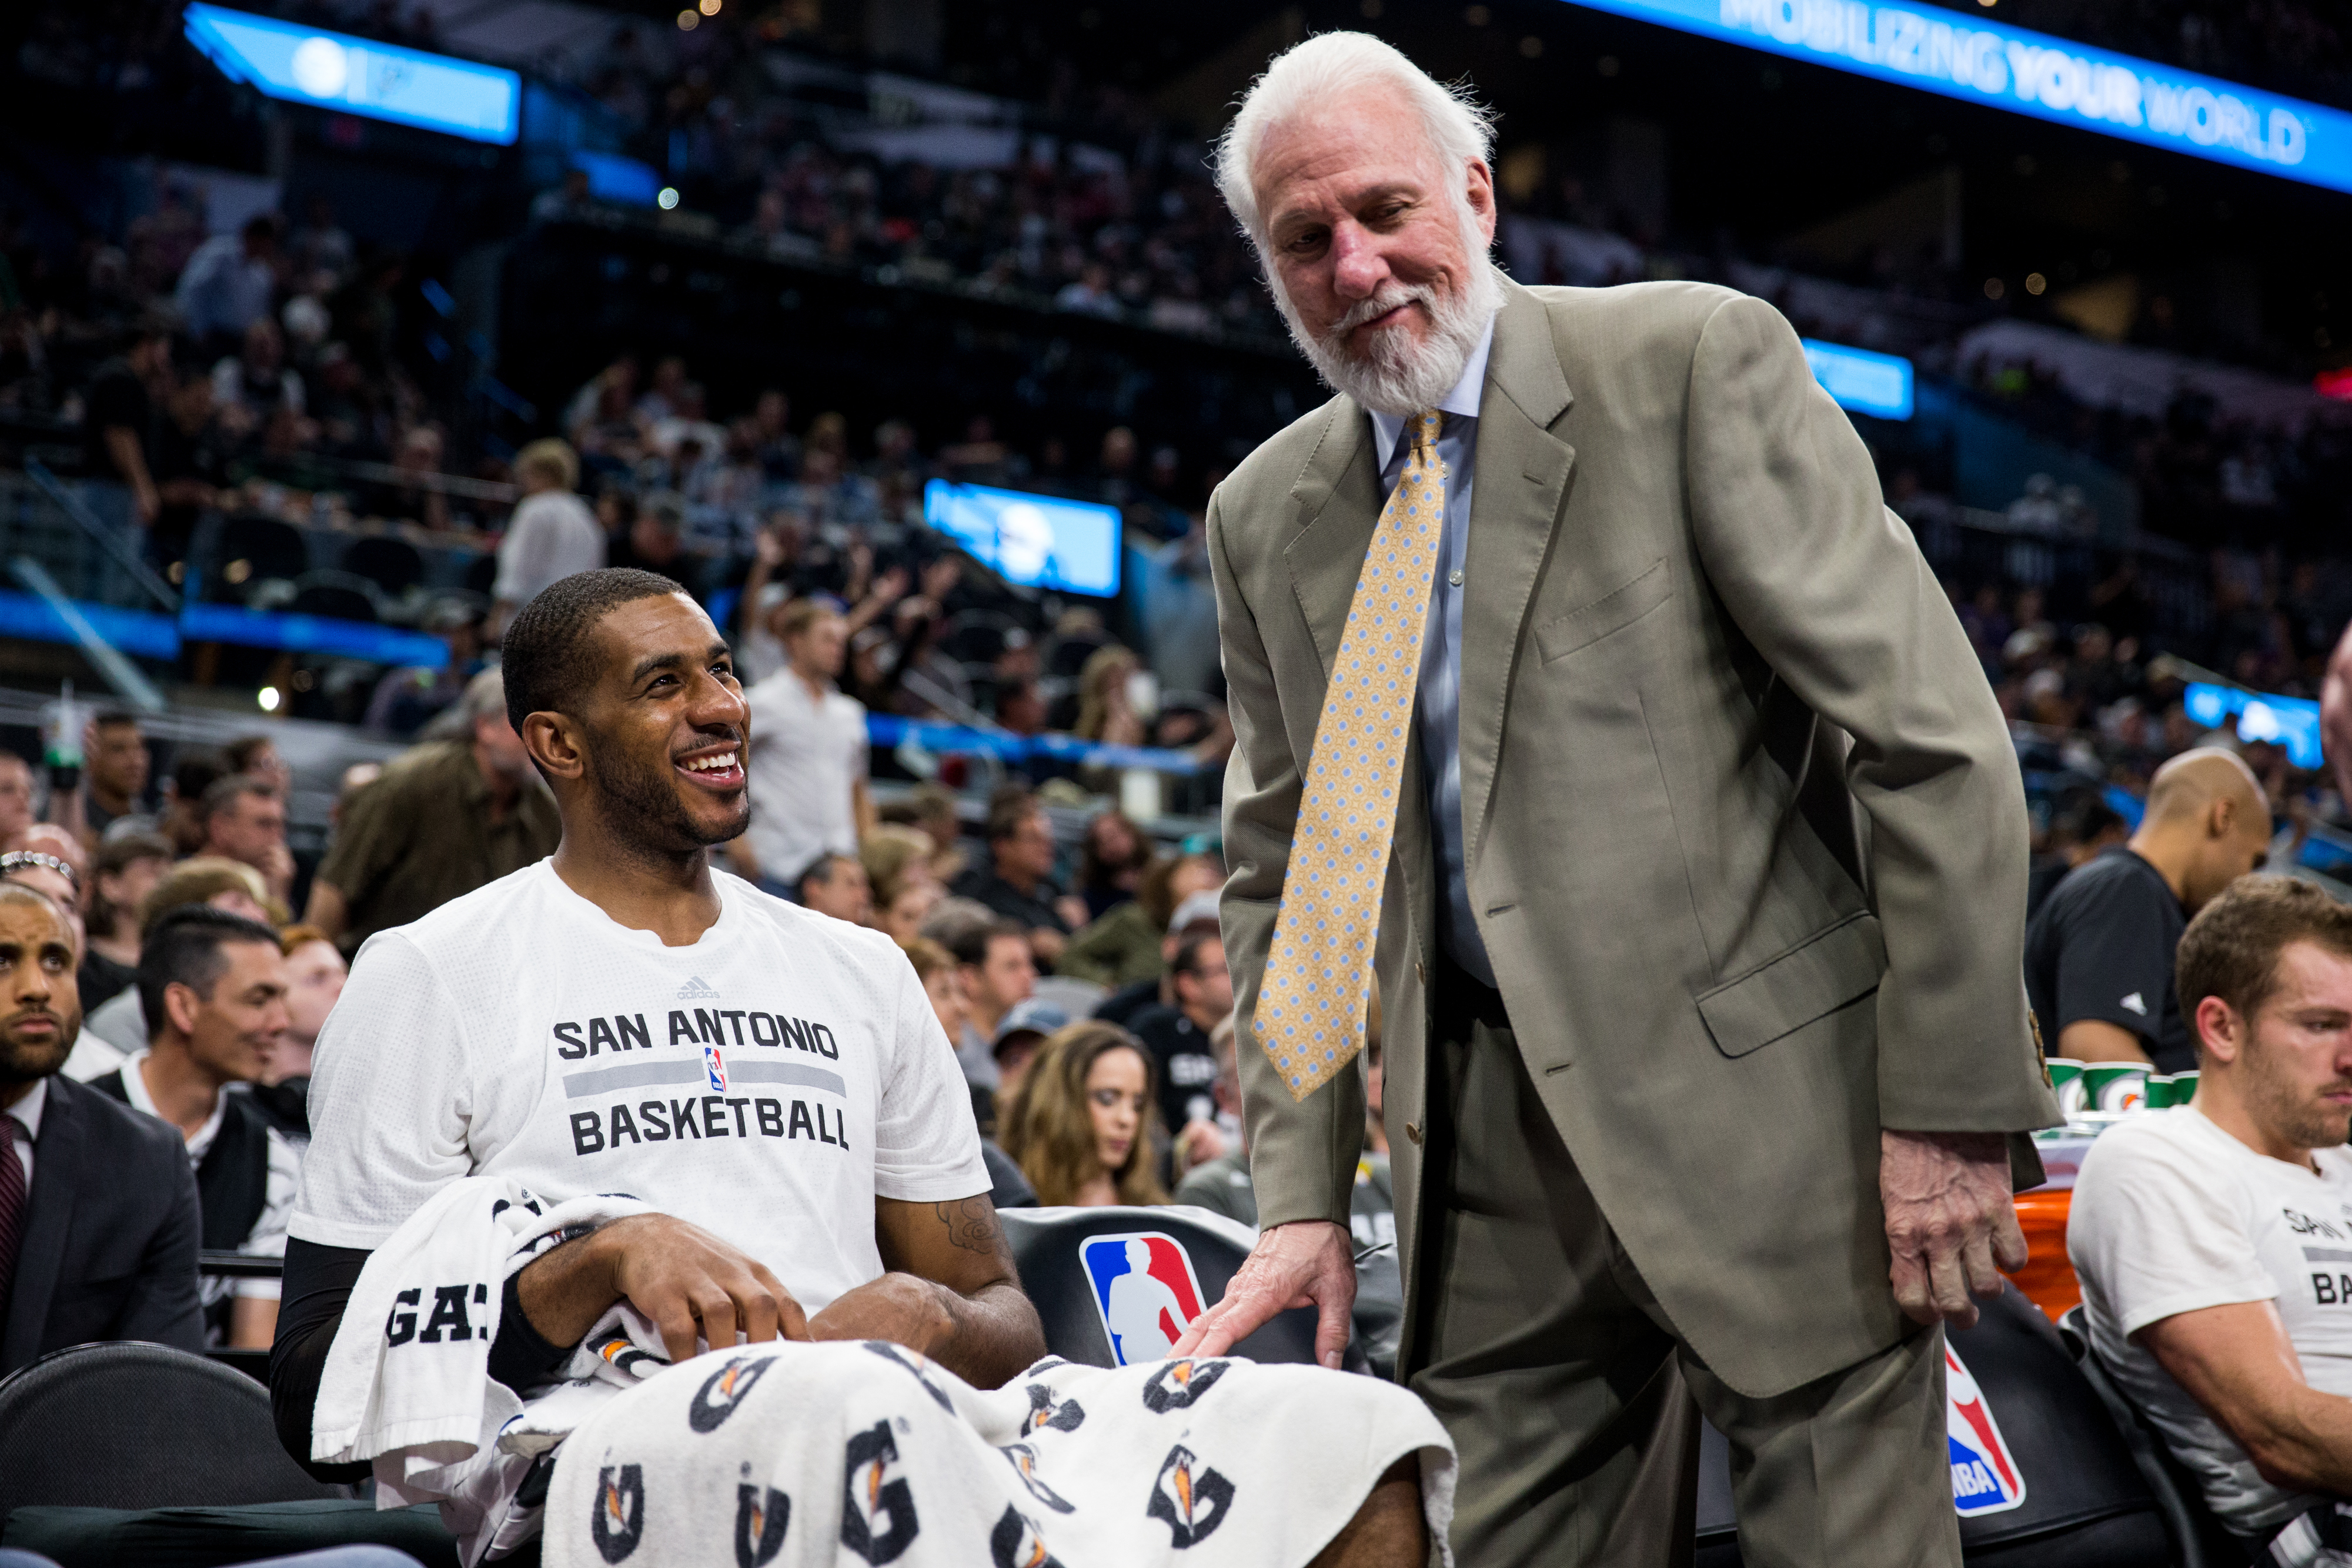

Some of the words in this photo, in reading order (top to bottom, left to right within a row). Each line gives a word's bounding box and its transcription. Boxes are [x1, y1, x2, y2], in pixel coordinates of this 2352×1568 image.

[2007, 40, 2143, 128] YOUR
[2142, 76, 2306, 165] WORLD
[677, 989, 720, 1000] adidas
[553, 1013, 652, 1060] SAN
[669, 1008, 839, 1061] ANTONIO
[569, 1095, 850, 1156] BASKETBALL
